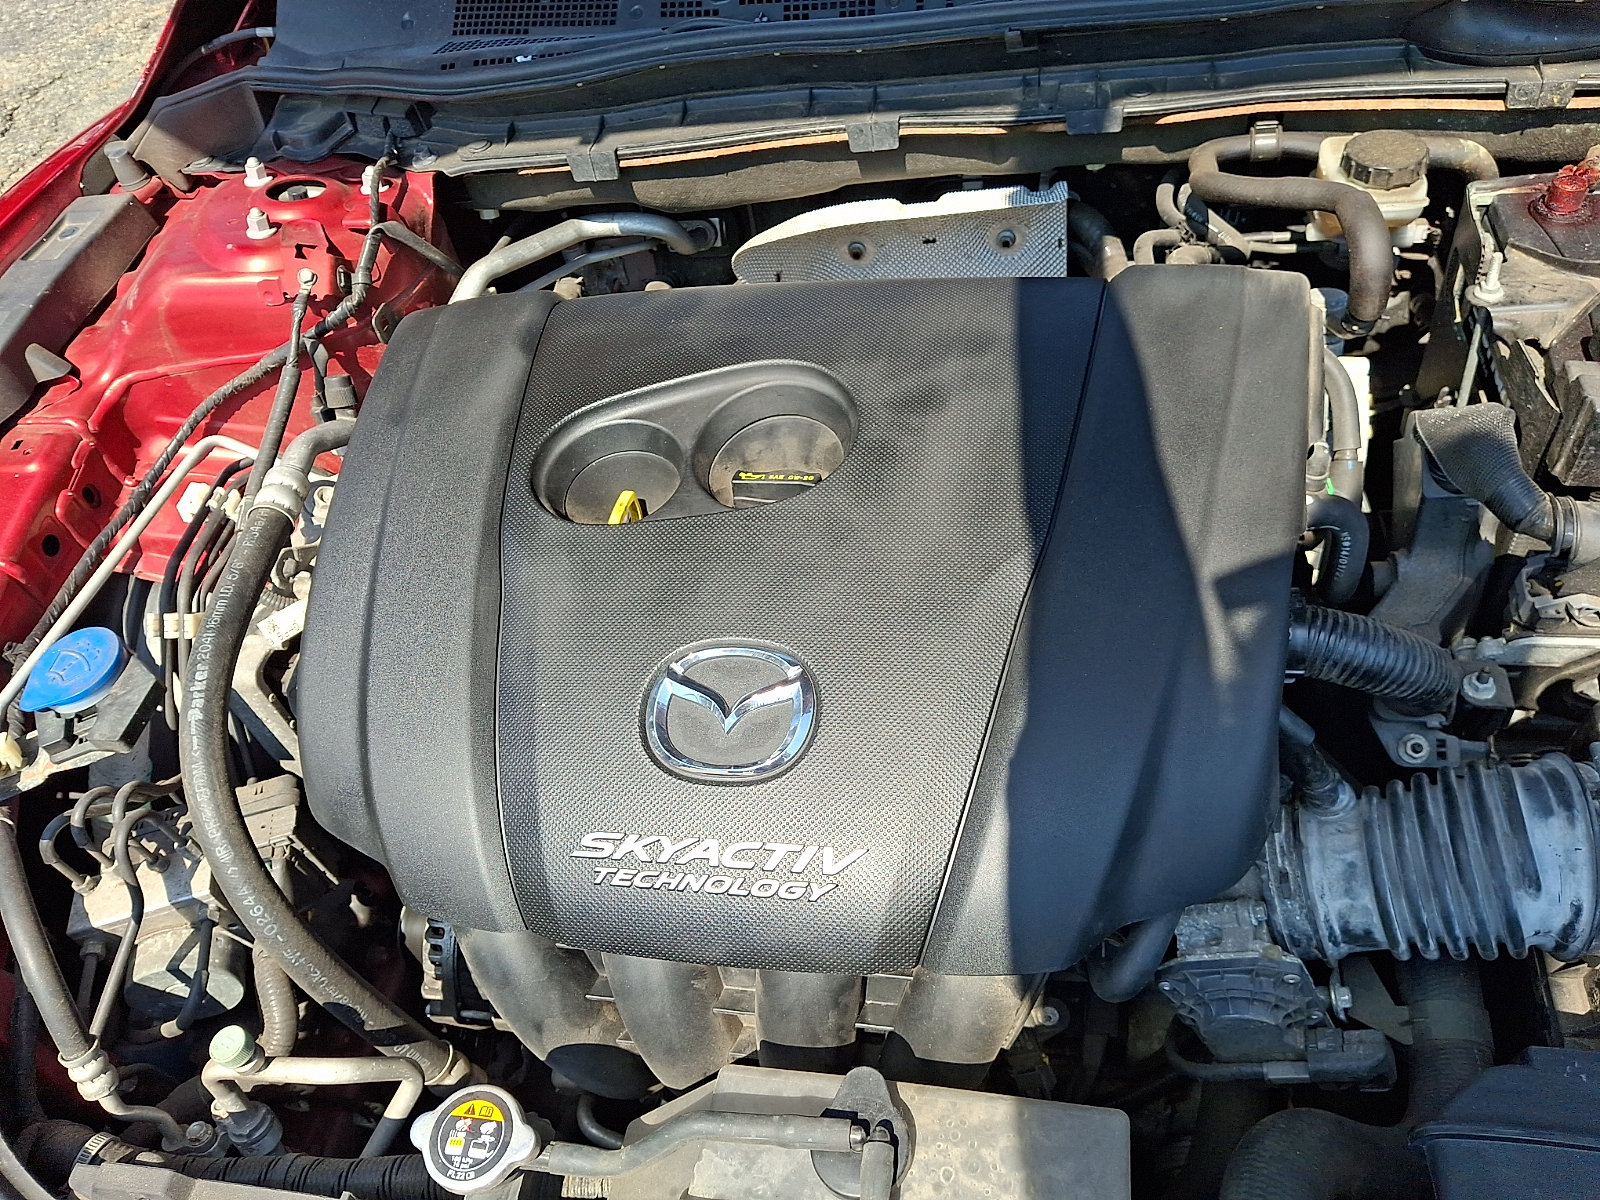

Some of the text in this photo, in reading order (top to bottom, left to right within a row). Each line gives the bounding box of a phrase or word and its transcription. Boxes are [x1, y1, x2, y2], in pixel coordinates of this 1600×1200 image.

[187, 663, 209, 721] Parker
[570, 831, 870, 876] SKYACTIV
[593, 867, 839, 902] TECHNOLOGY
